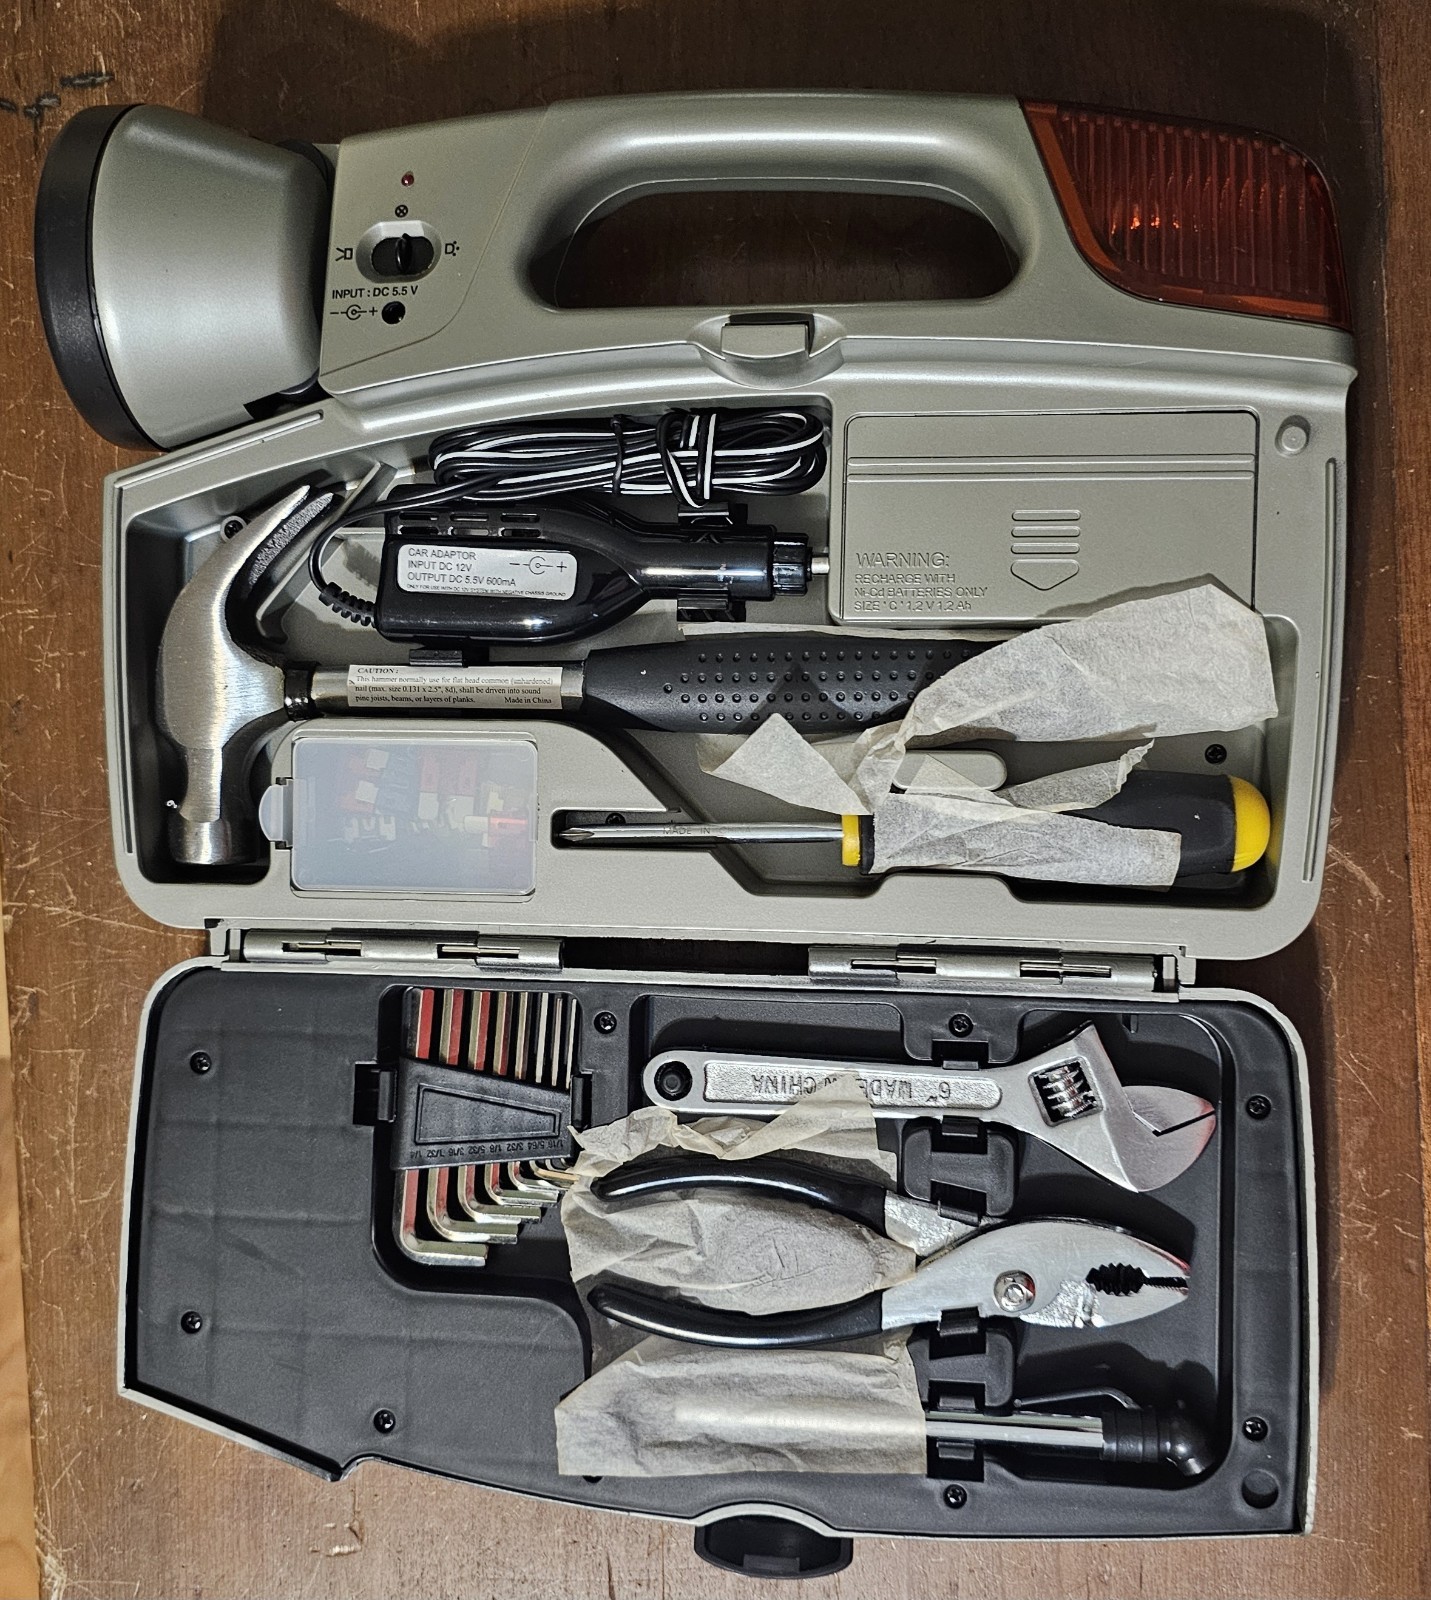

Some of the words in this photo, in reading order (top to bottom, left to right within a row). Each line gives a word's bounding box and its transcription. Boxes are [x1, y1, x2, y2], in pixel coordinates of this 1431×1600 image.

[332, 288, 364, 299] INPUT
[373, 286, 390, 297] DC
[392, 286, 408, 296] 5.5
[410, 285, 418, 295] V
[408, 548, 428, 558] CAR
[431, 550, 476, 560] ADAPTOR
[856, 552, 950, 568] WARNING:
[408, 560, 436, 570] INPUT
[439, 562, 452, 570] DC
[456, 564, 472, 572] 12V
[407, 572, 446, 582] OUTPUT
[449, 574, 463, 583] DC
[465, 575, 484, 584] 5.5V
[486, 576, 516, 586] 600mA
[855, 574, 922, 584] RECHARGE
[925, 573, 956, 584] WITH
[854, 587, 884, 598] Ni-Cd
[888, 587, 952, 598] BATTERIES
[956, 587, 988, 598] ONLY
[854, 601, 880, 612] SIZE
[906, 601, 924, 612] 1.2
[925, 601, 935, 611] V
[938, 601, 954, 612] 1.2
[956, 601, 972, 612] Ah
[751, 1074, 817, 1096] CHINA
[468, 1145, 486, 1154] 5/32
[489, 1144, 502, 1152] 1/8
[506, 1142, 524, 1151] 3/32
[527, 1140, 545, 1149] 5/64
[449, 1148, 464, 1156] 3/16
